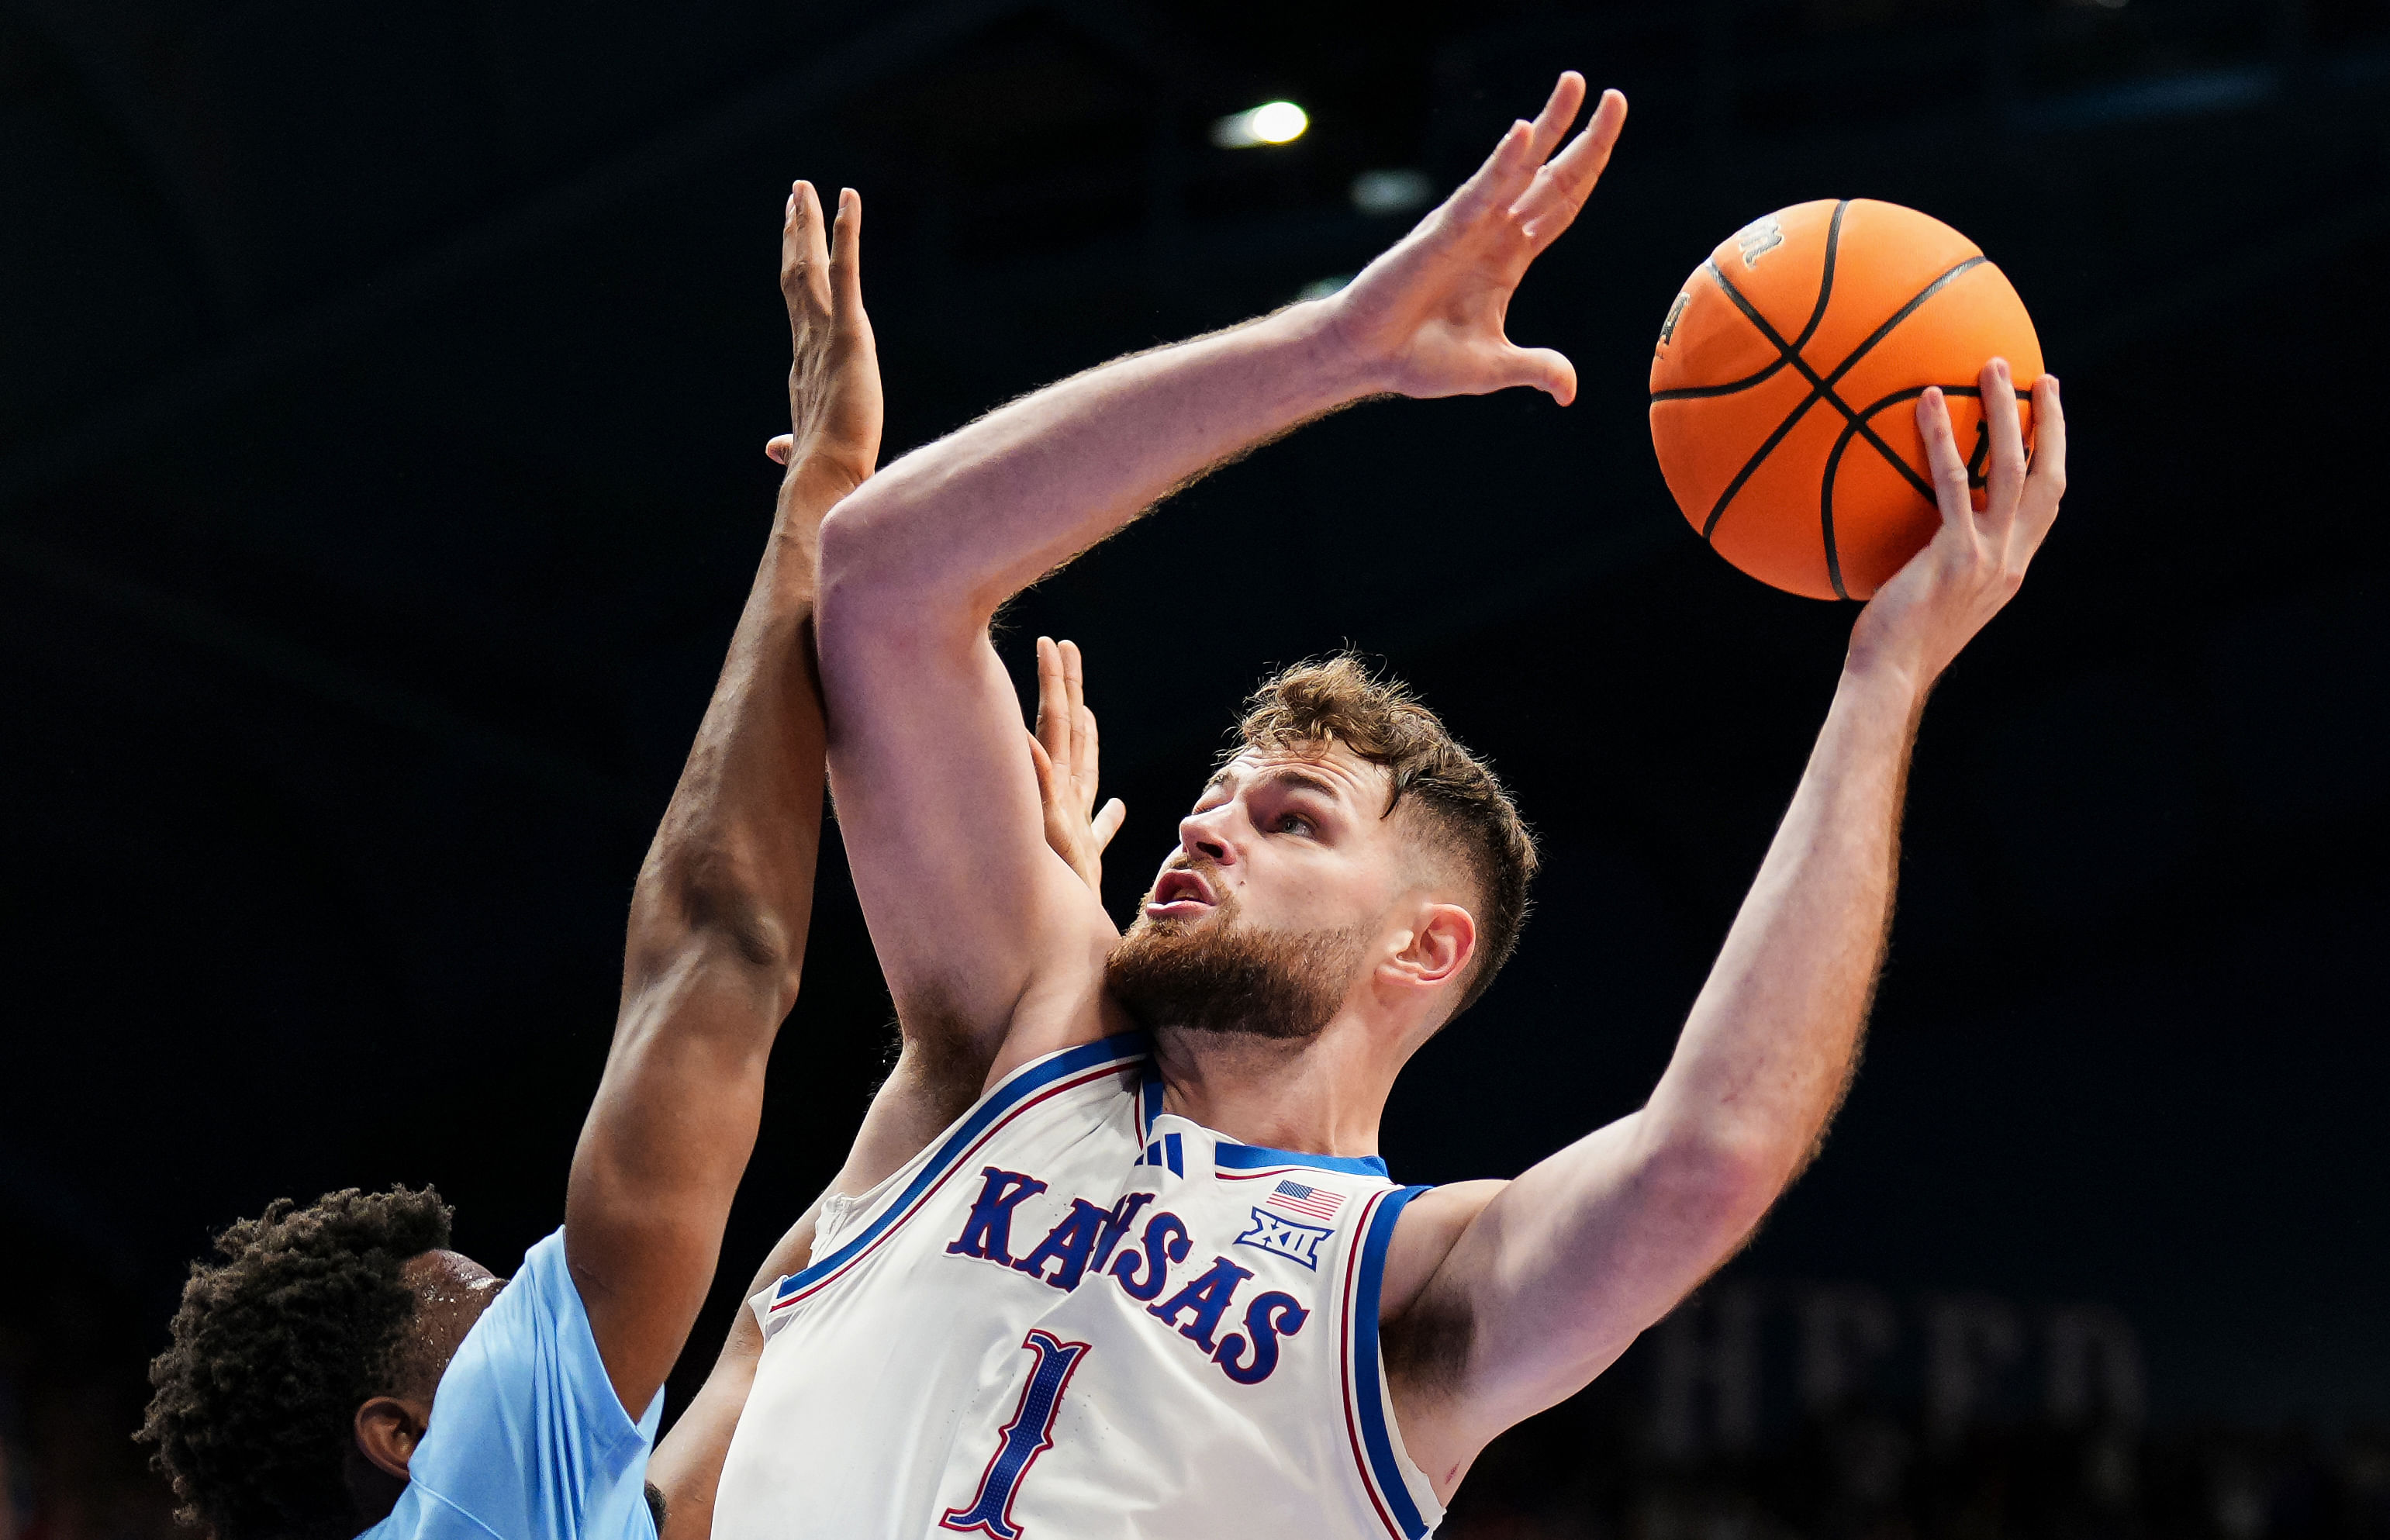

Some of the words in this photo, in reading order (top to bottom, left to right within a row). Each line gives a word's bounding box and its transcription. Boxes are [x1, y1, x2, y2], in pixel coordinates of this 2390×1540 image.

[946, 1166, 1311, 1385] KANSAS
[1232, 1206, 1335, 1272] XII
[938, 1328, 1093, 1540] 1
